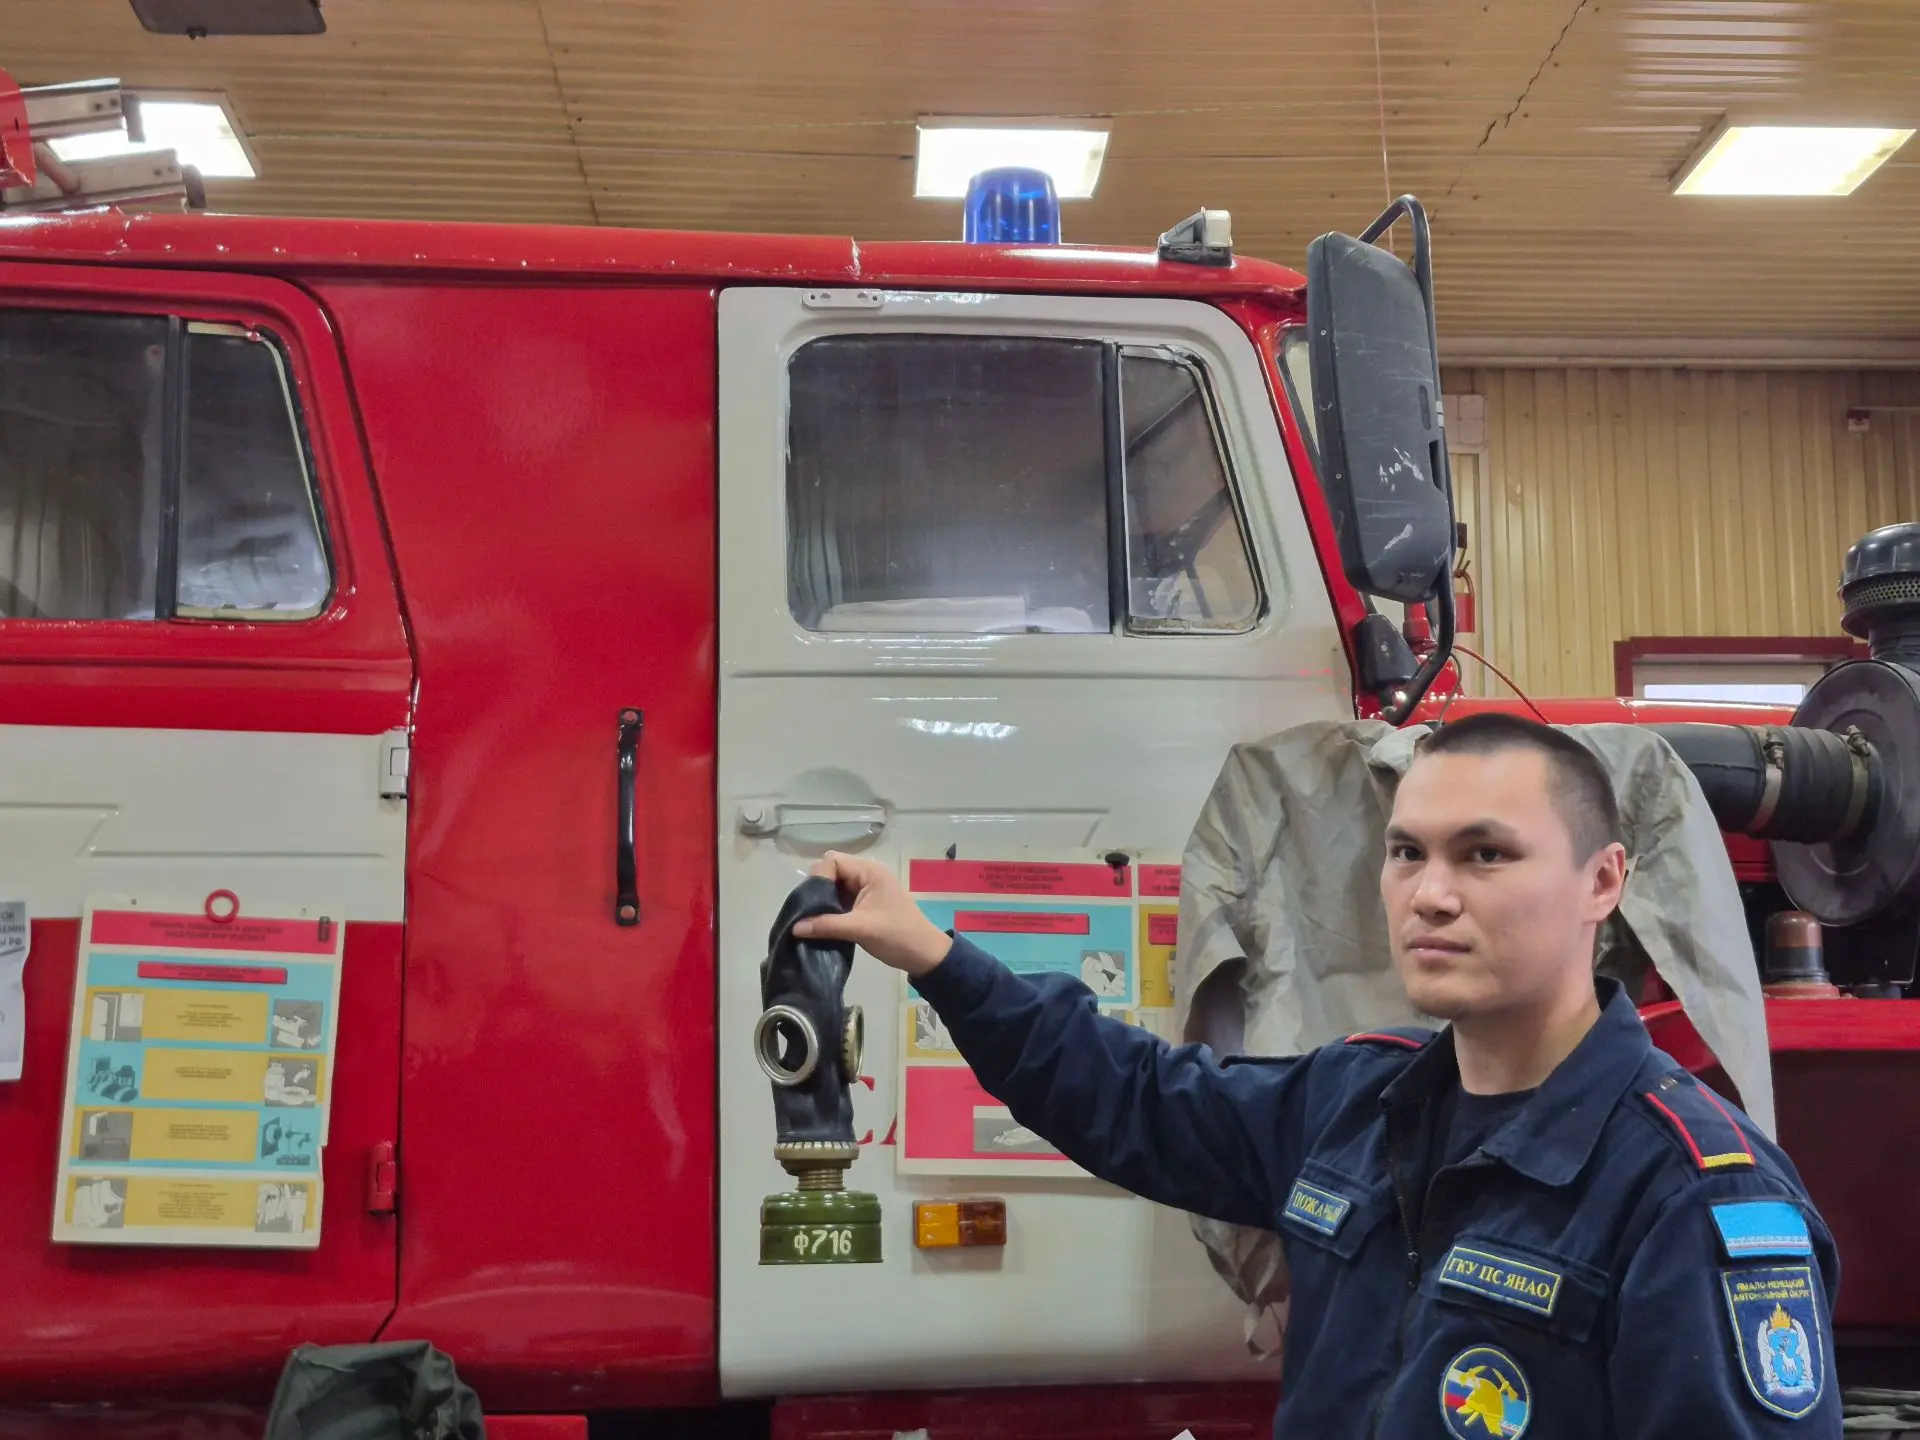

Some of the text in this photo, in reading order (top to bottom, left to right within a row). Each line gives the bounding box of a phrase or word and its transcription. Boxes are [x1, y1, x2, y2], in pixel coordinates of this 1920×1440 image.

[794, 1229, 853, 1256] Ф716
[1448, 1257, 1552, 1298] ГКУ ПС ЯНАО
